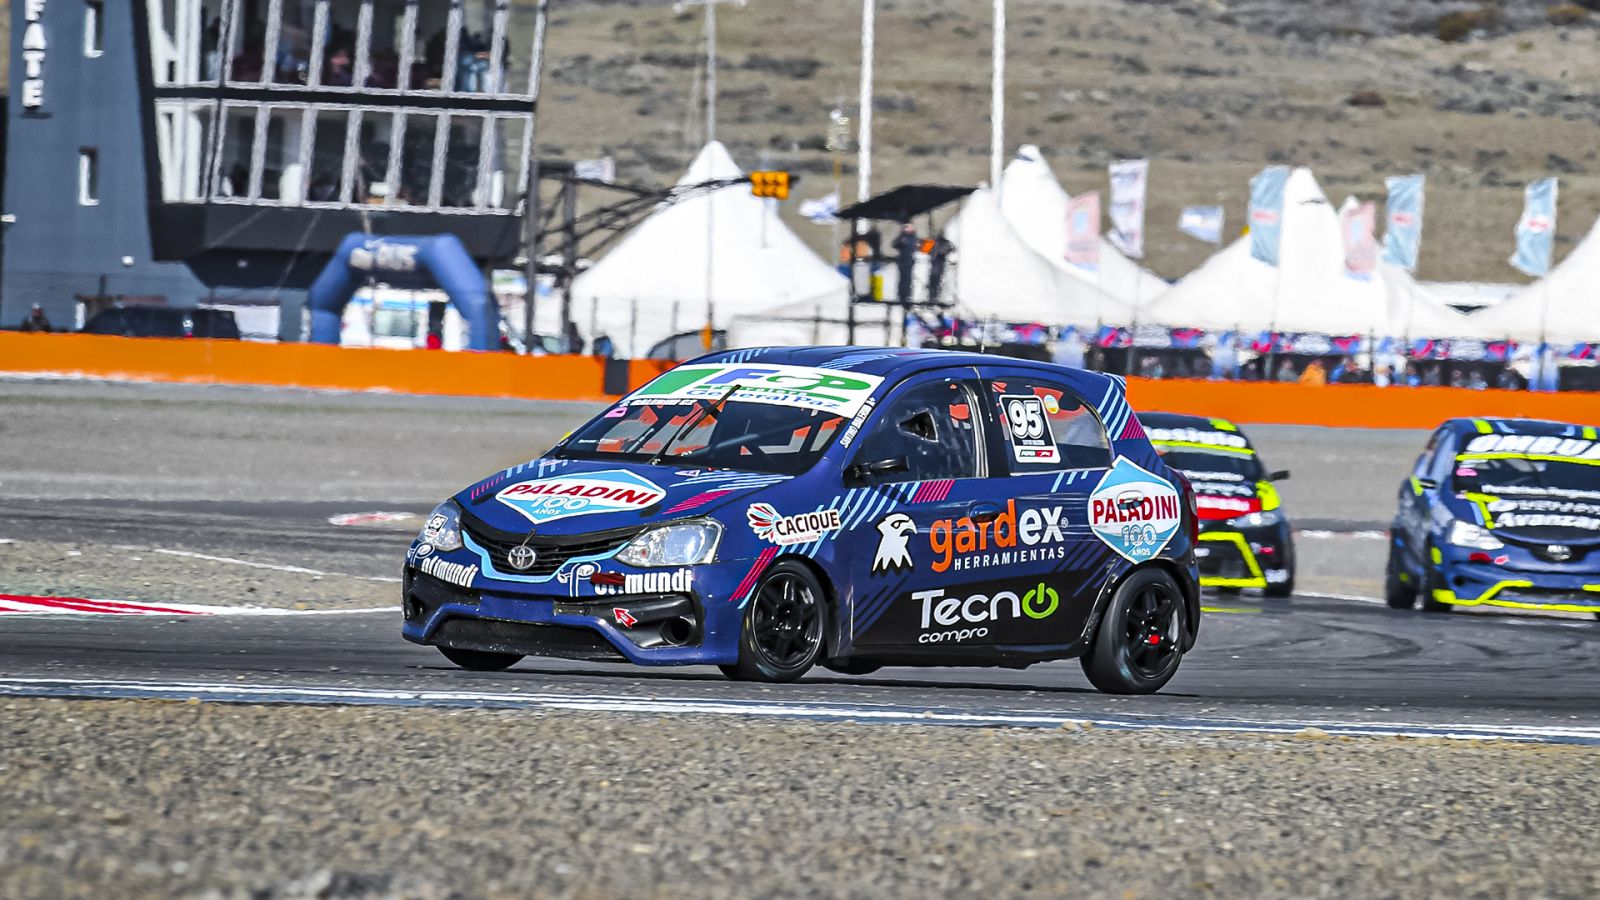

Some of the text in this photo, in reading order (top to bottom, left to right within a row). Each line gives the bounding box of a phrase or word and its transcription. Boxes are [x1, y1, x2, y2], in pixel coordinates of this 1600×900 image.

[23, 0, 47, 107] FATE
[793, 396, 841, 408] Paz
[1008, 399, 1045, 439] 95
[504, 484, 660, 505] PALADINI
[531, 496, 591, 510] 100
[1093, 495, 1178, 525] PALADINI
[775, 511, 839, 536] CACIQUE
[929, 499, 1065, 573] gardex
[1122, 523, 1157, 547] 100
[954, 546, 1065, 571] HERRAMIENTAS
[911, 582, 1060, 629] Tecno
[918, 627, 988, 643] compro
